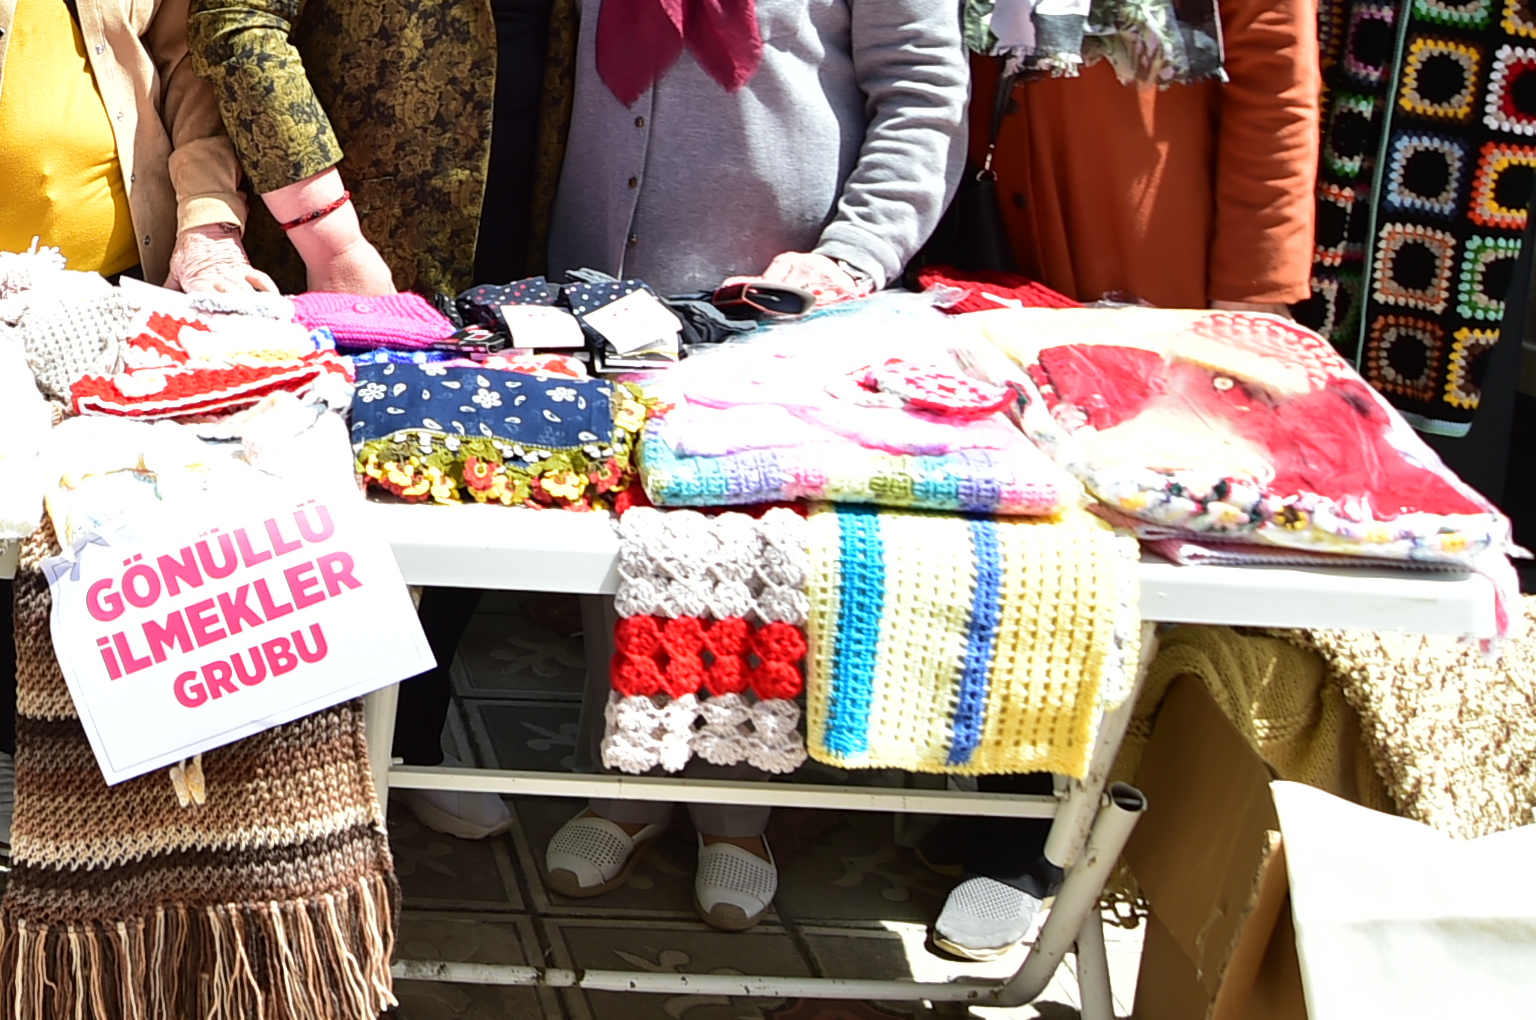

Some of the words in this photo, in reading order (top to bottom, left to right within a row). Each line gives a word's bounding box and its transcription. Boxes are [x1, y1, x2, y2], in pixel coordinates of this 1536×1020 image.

[86, 499, 336, 622] GÖNÜLLÜ
[96, 551, 364, 681] İLMEKLER
[172, 623, 329, 708] GRUBU
